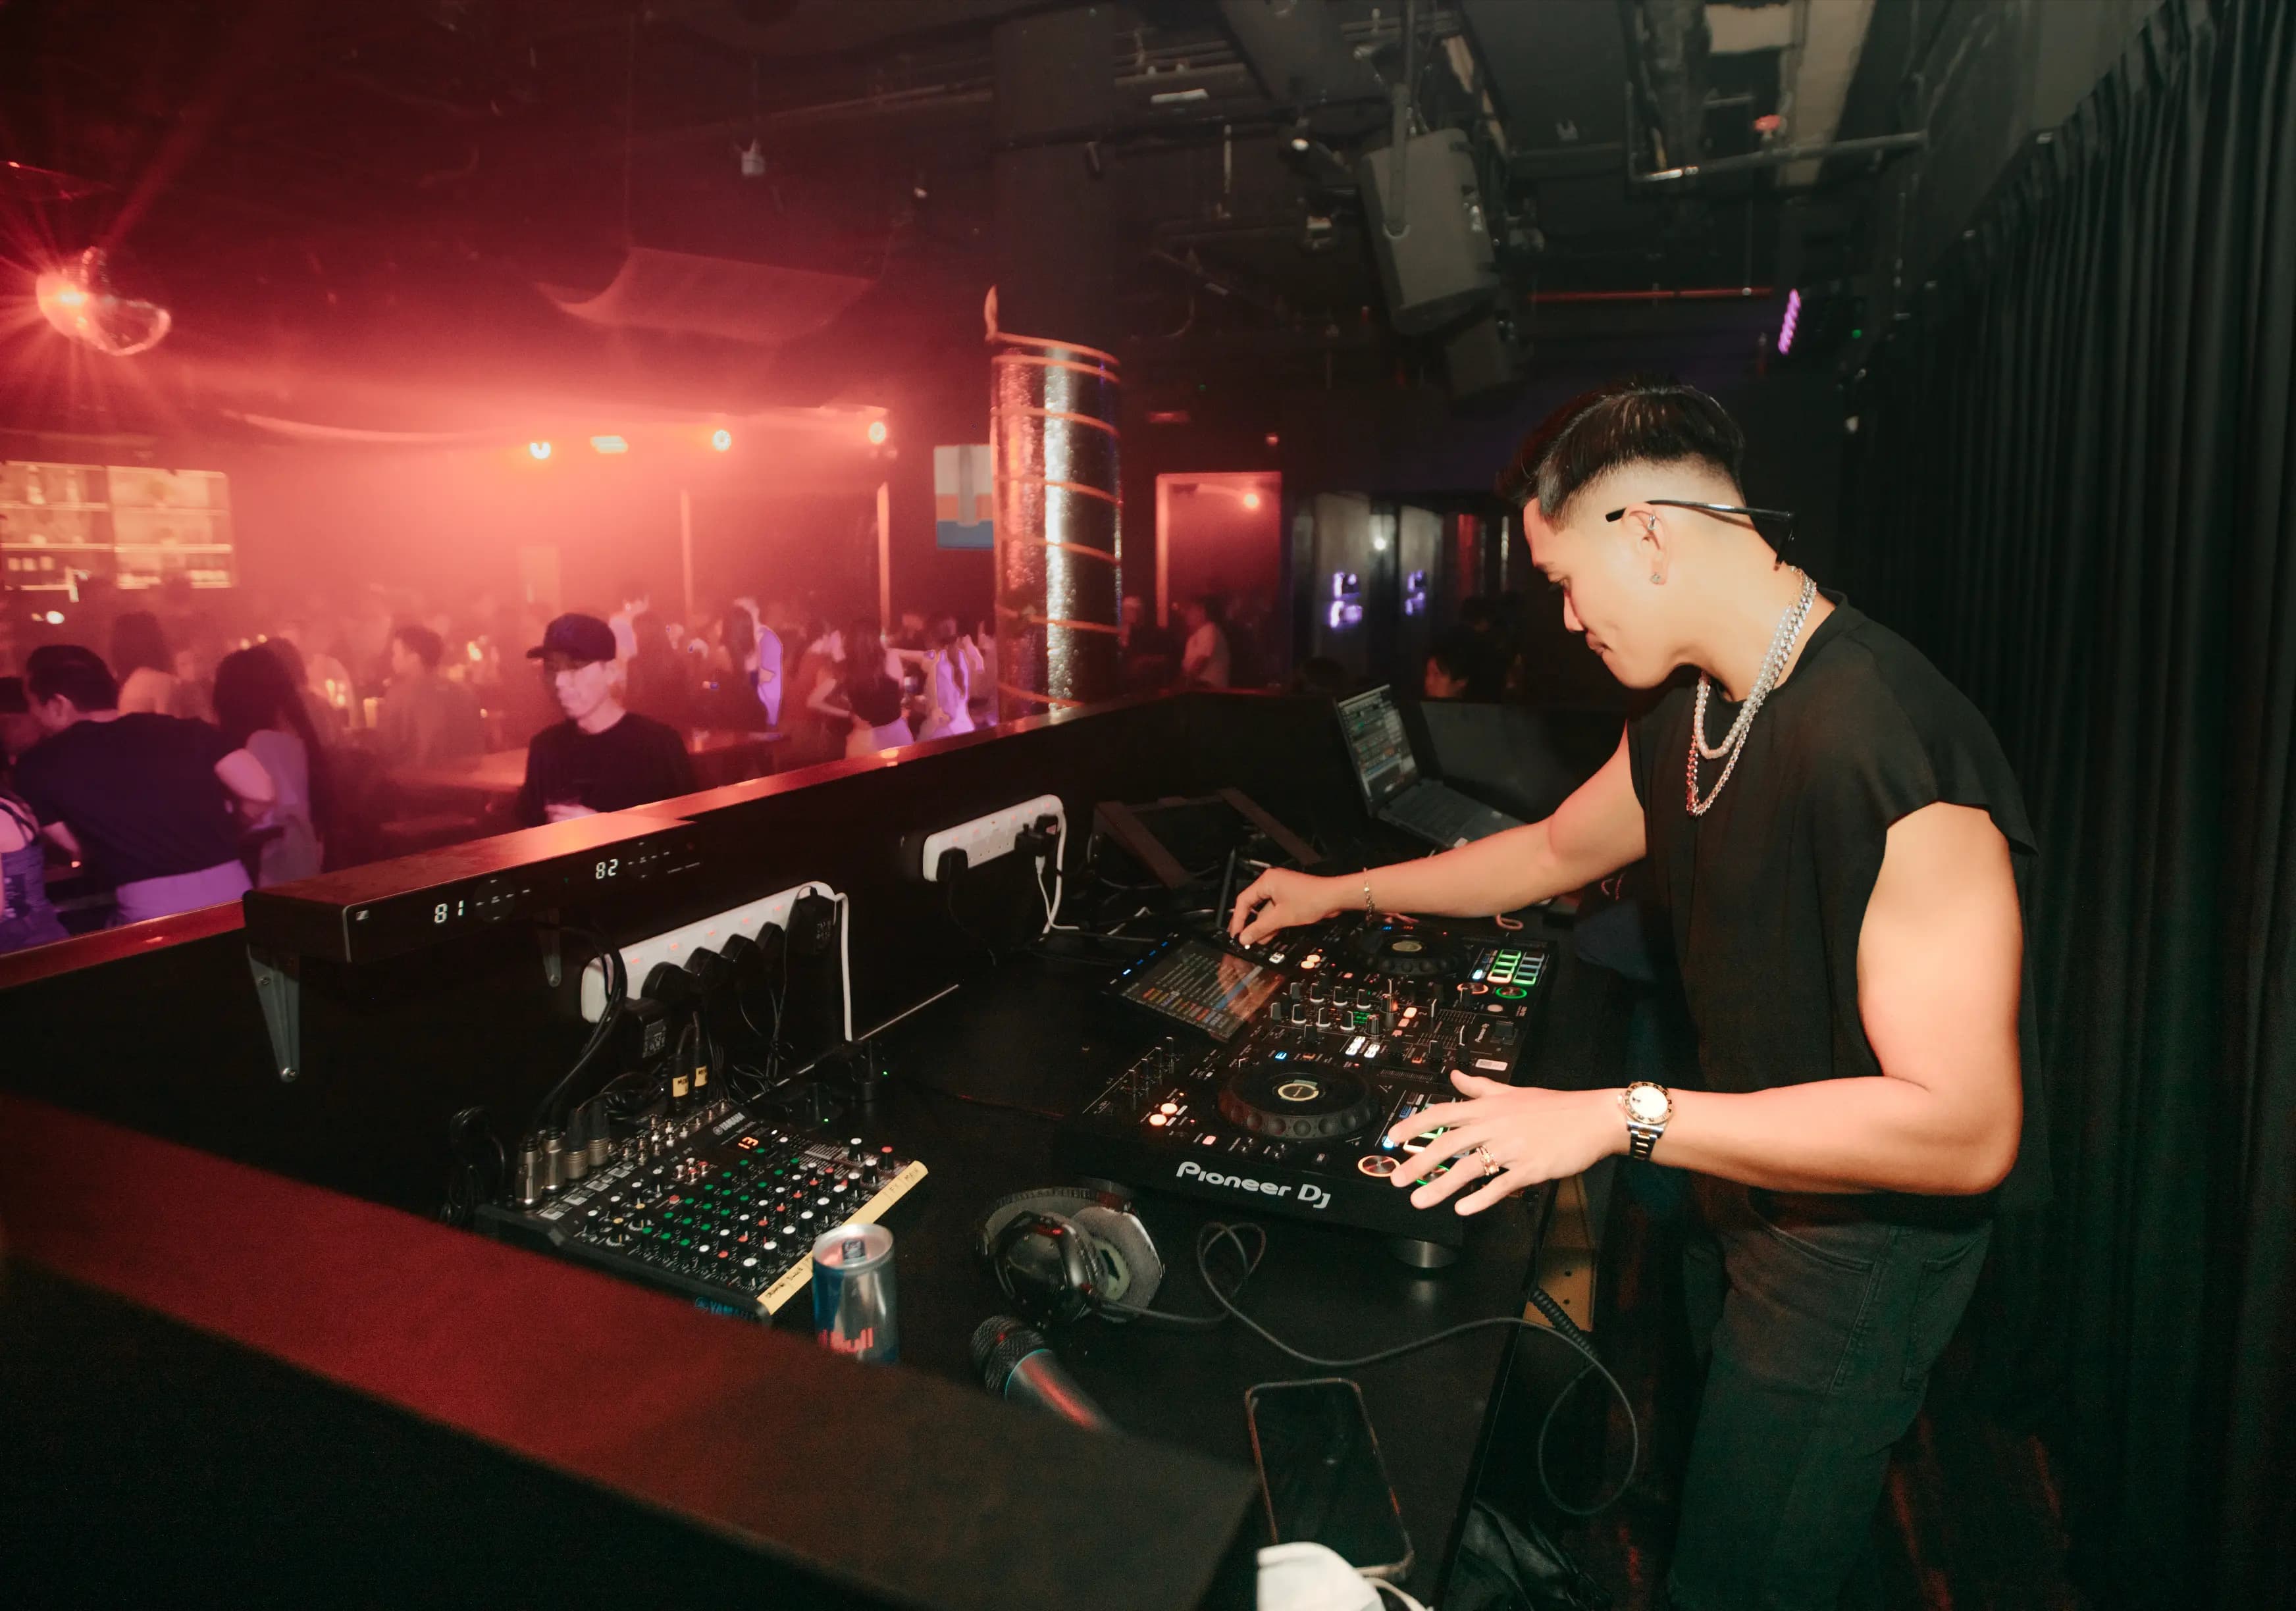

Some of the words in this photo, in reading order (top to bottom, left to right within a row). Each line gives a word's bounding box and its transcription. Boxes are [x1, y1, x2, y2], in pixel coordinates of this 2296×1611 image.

[595, 858, 619, 880] 82
[434, 900, 464, 924] 81
[1176, 1161, 1292, 1196] Pioneer
